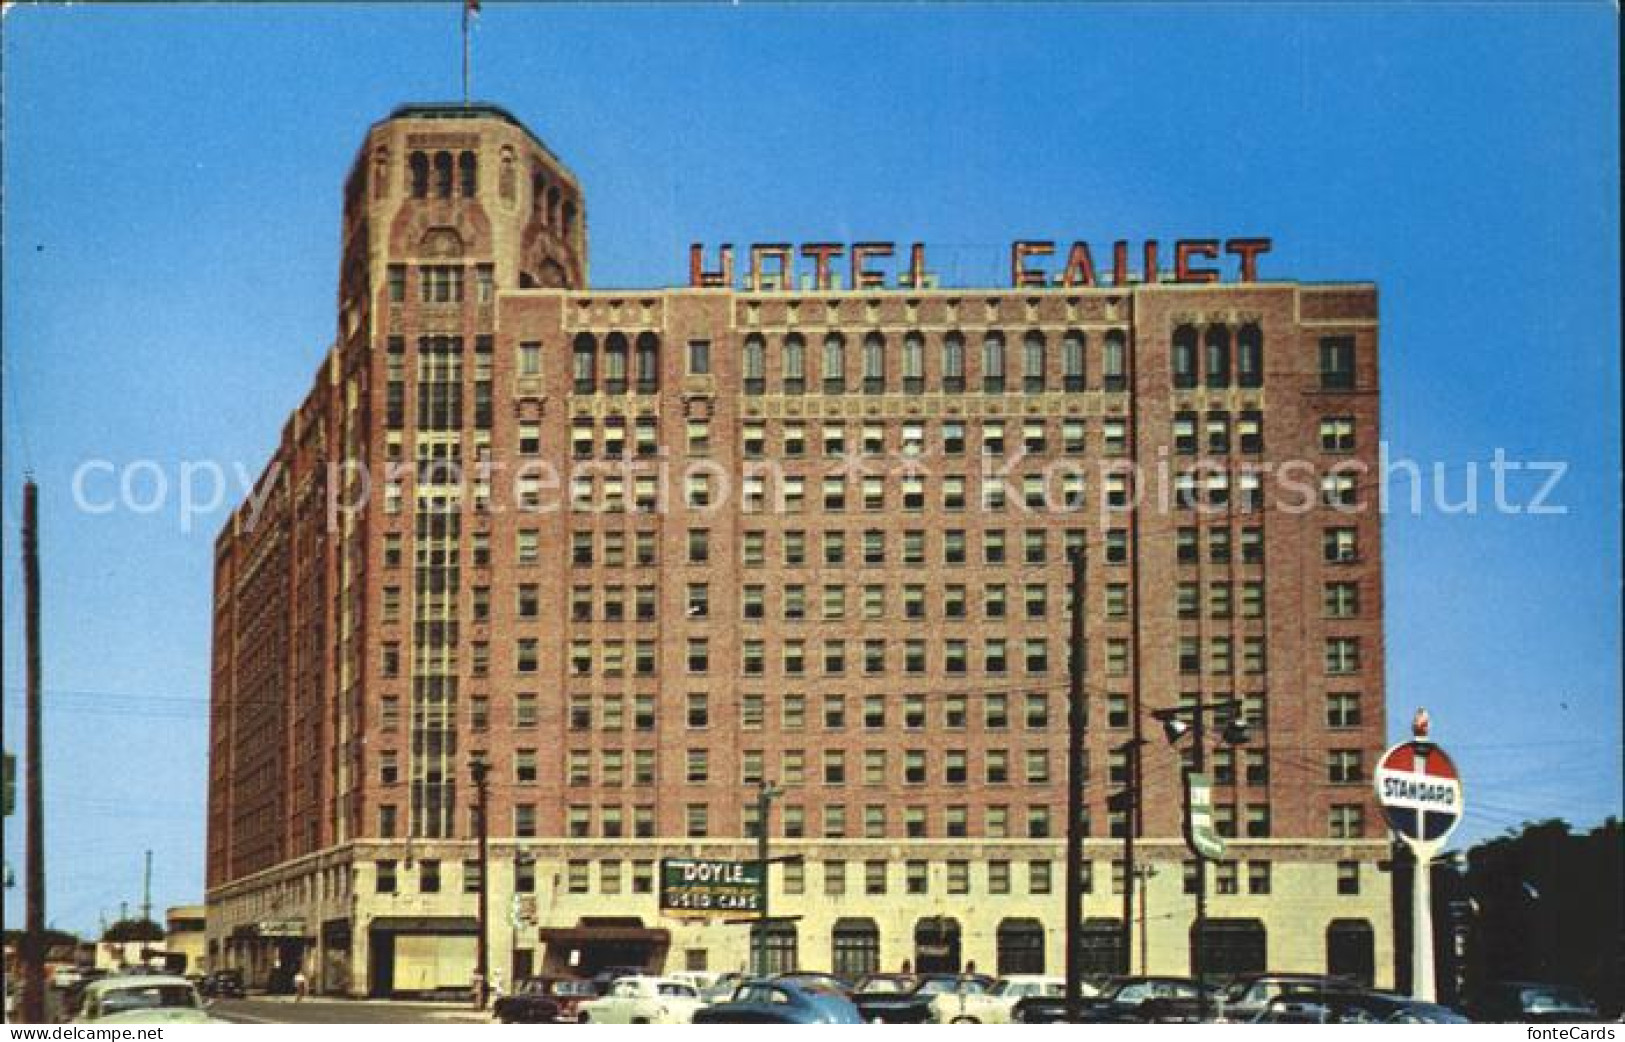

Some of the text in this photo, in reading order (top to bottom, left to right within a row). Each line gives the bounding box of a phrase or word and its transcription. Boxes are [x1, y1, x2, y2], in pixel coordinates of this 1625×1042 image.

[690, 238, 1272, 290] HOTEL FAUST
[1384, 777, 1454, 806] STANDARD
[684, 863, 744, 882] DOYLE
